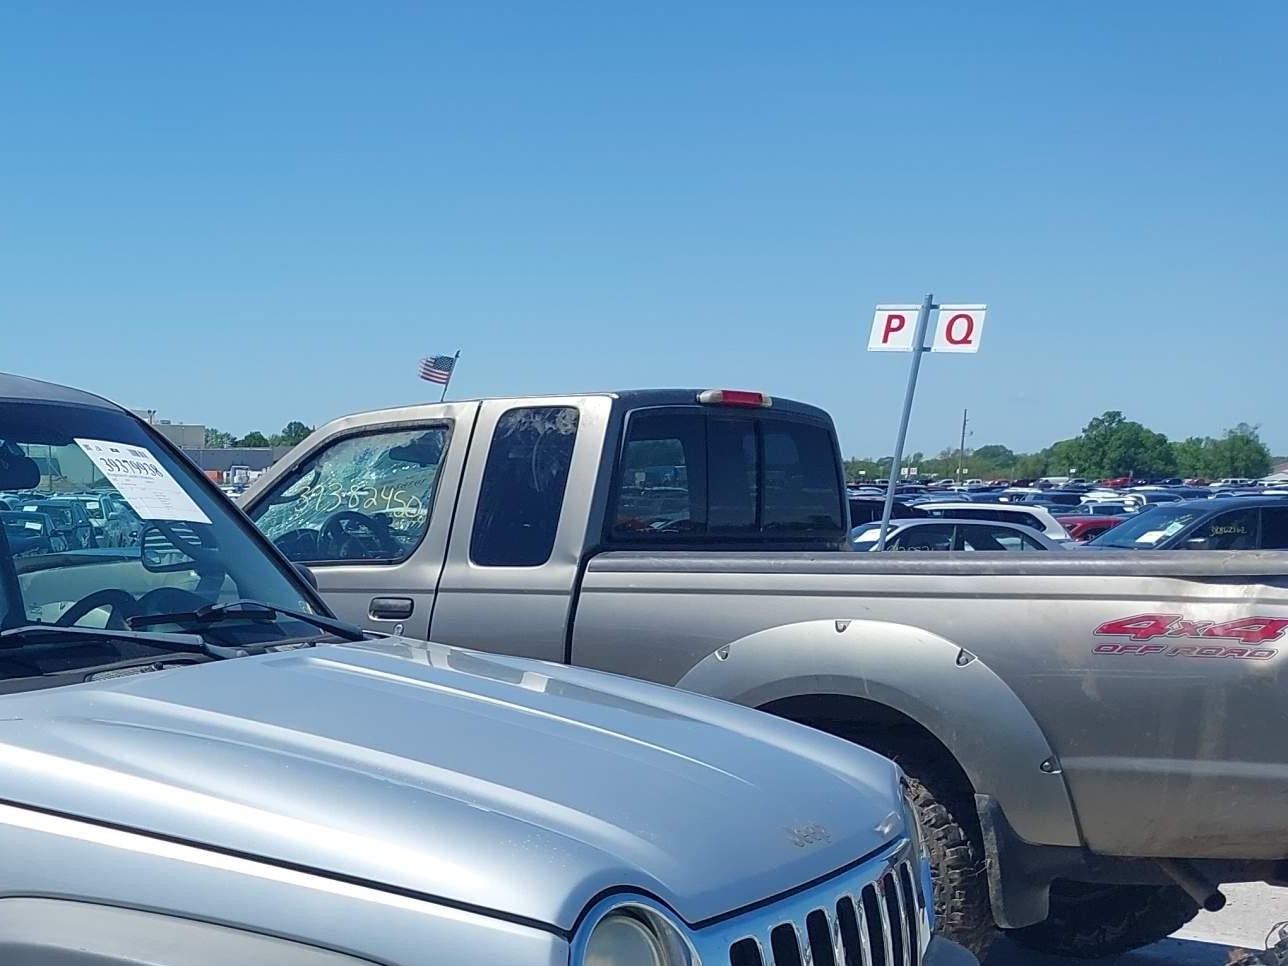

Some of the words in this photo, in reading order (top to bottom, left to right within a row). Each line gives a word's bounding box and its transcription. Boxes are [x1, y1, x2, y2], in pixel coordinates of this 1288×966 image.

[881, 314, 906, 344] P
[945, 313, 974, 345] Q
[100, 457, 164, 478] 39379938
[1092, 643, 1168, 655] OFF
[1167, 646, 1279, 660] ROAD
